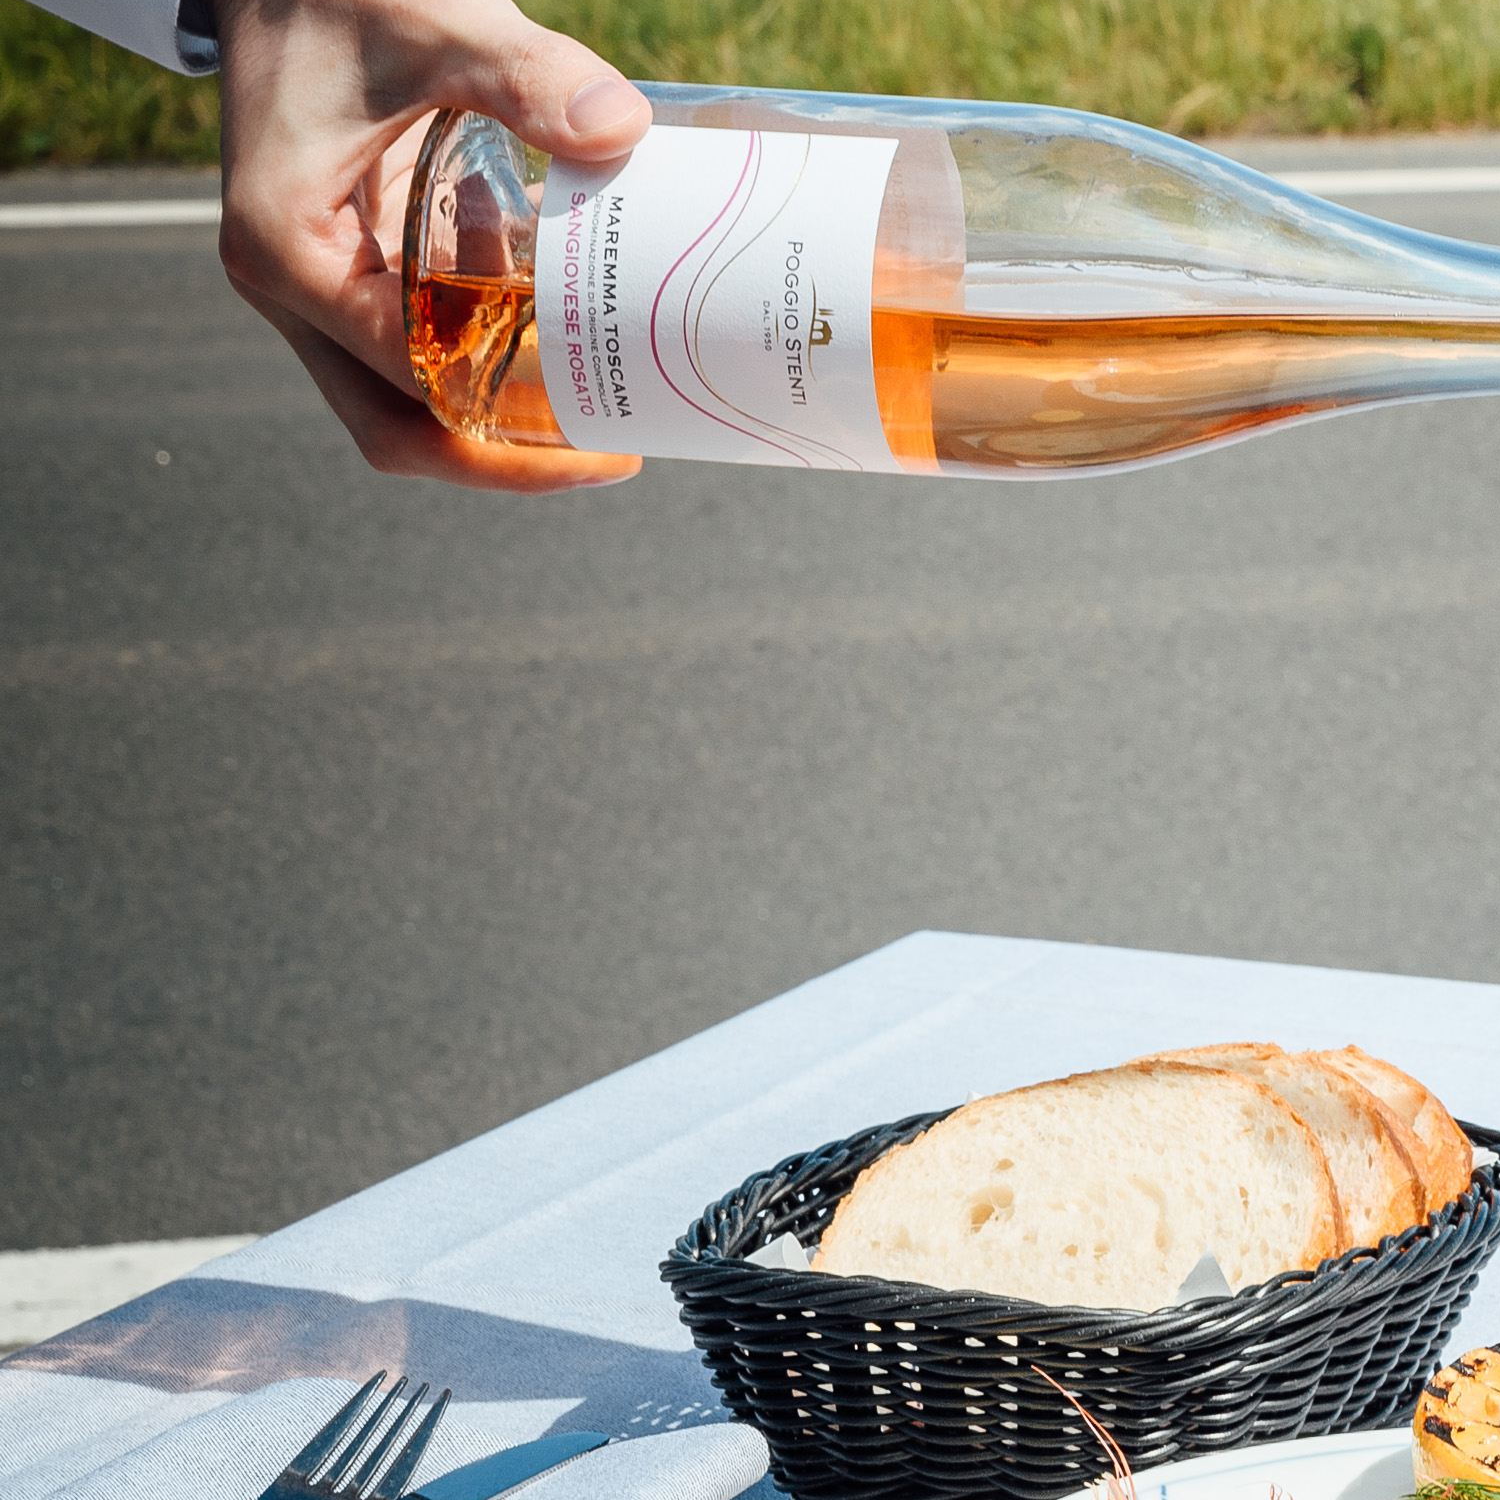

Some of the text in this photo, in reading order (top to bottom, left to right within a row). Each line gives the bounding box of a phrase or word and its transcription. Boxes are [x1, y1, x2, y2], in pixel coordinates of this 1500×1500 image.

[587, 193, 604, 289] DENOMINAZIONE
[564, 192, 595, 417] SANGIOVESE ROSATO
[587, 291, 595, 304] DI
[587, 306, 598, 353] ORIGINE
[603, 196, 632, 418] MAREMMA TOSCANA
[763, 300, 773, 352] DAL 1950
[784, 241, 807, 405] POGGIO STENTI
